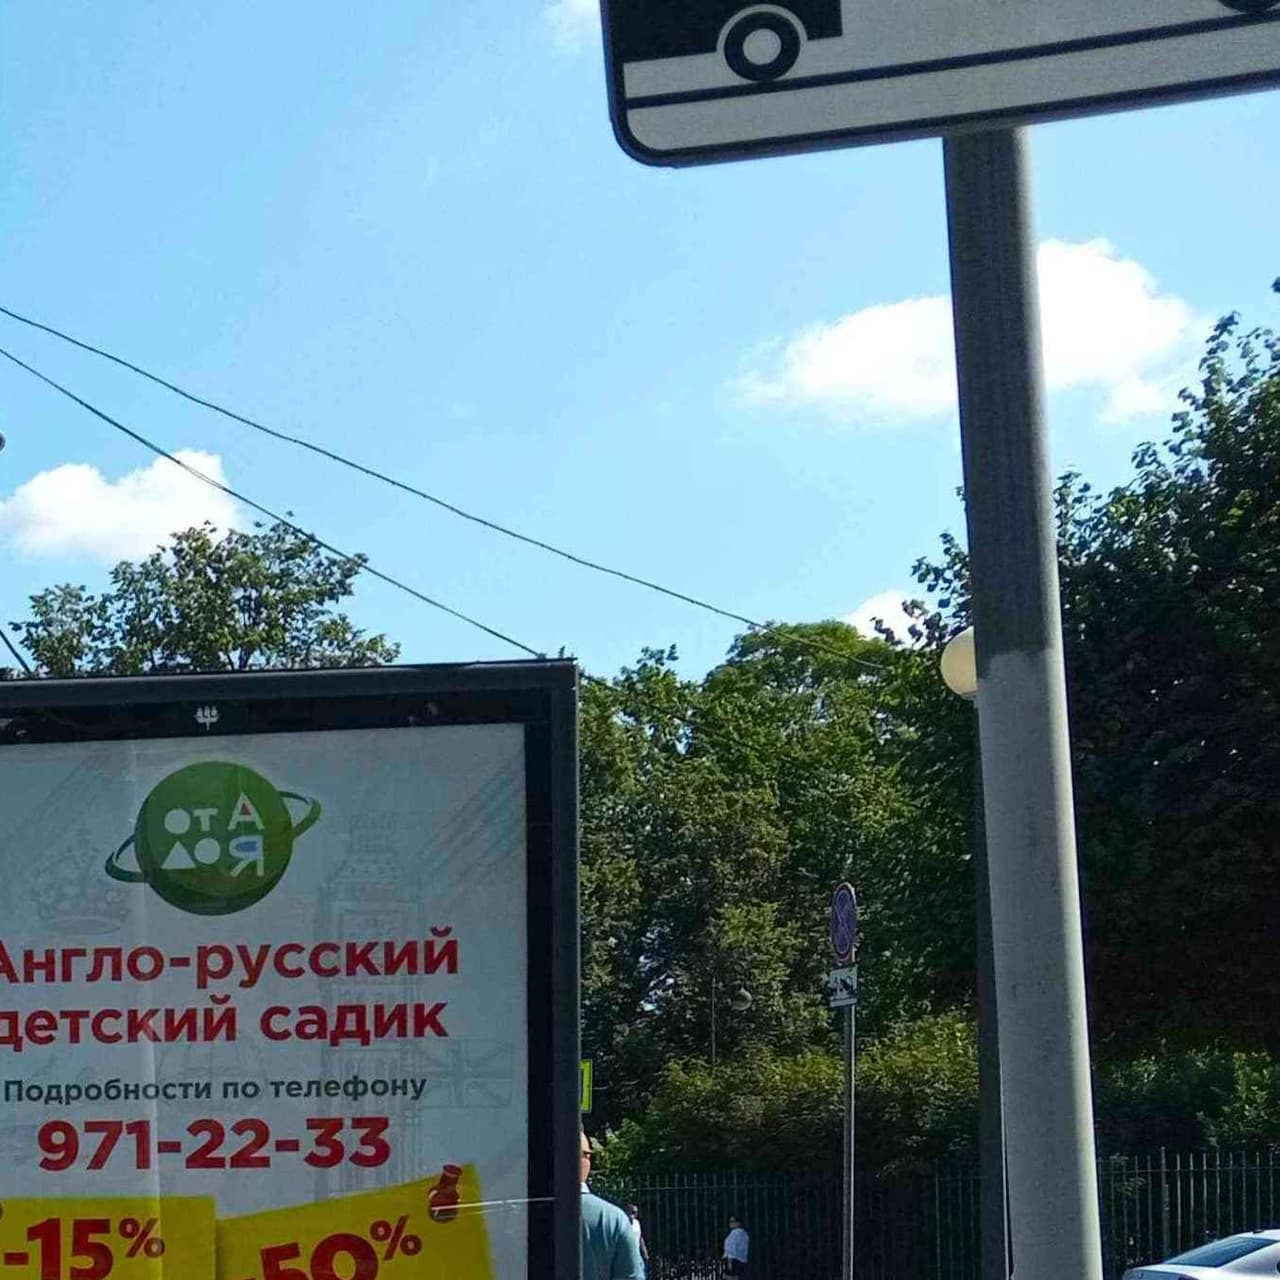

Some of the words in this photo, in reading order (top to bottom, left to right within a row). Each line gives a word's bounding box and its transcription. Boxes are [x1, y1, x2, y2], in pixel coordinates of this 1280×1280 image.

[259, 1001, 449, 1047] садик
[4, 1077, 212, 1105] Подробности
[222, 1078, 260, 1101] по
[269, 1074, 427, 1101] телефону
[37, 1116, 392, 1171] 971-22-33
